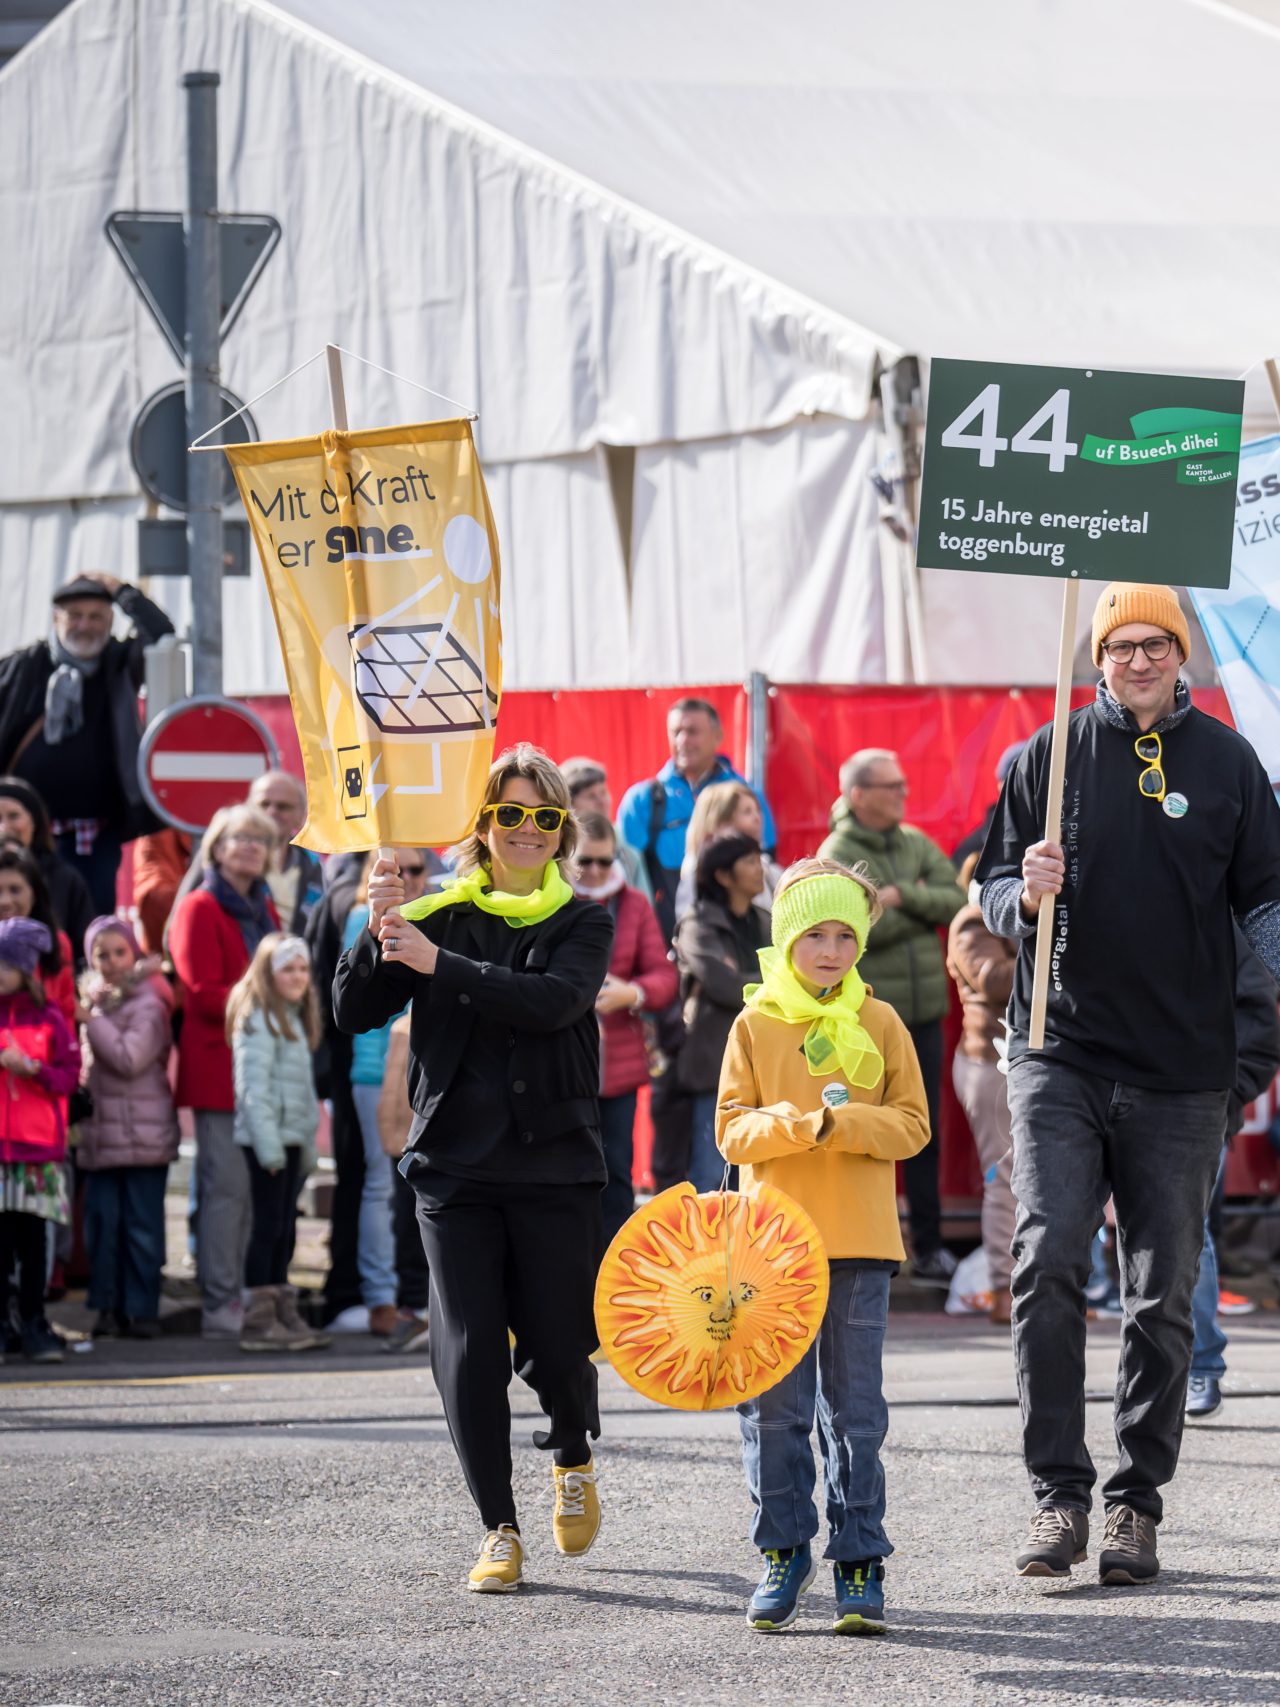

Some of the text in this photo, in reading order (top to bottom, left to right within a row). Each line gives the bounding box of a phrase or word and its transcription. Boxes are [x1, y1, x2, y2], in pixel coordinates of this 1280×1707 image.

[941, 383, 1078, 473] 44
[1095, 432, 1219, 461] uf Bsuech dihei
[250, 484, 310, 522] Mit
[346, 465, 436, 506] Kraft
[1207, 470, 1232, 481] GALLEN
[941, 497, 1149, 539] 15 Jahre energietal
[938, 531, 1066, 567] toggenburg
[1068, 822, 1079, 852] sind
[1052, 904, 1068, 992] energietal
